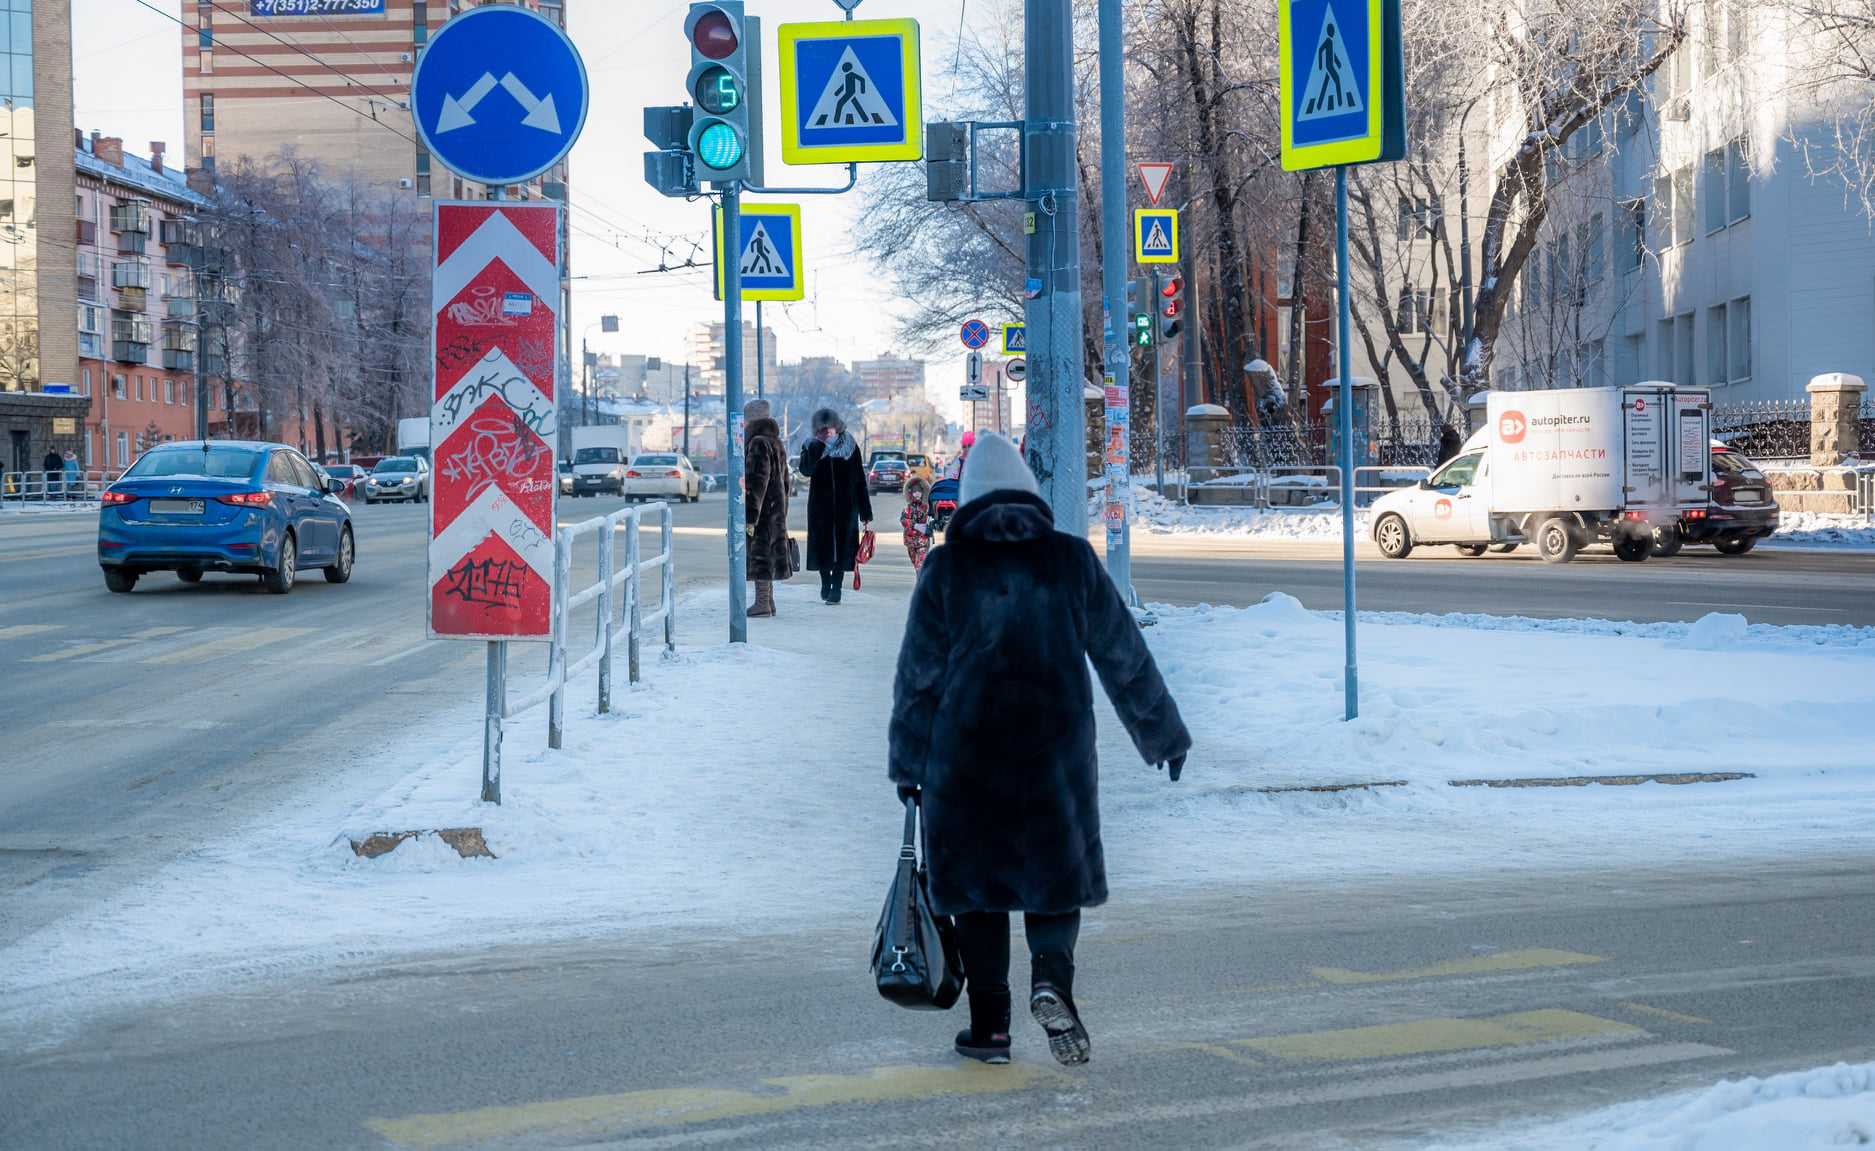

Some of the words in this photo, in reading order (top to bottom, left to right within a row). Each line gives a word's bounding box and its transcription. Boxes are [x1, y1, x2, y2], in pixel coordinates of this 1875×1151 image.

[255, 0, 379, 13] +7(351)2-777-350
[719, 75, 736, 107] 5
[1531, 414, 1591, 427] autopiter.ru
[1513, 448, 1607, 462] АВТОЗАПЧАСТИ
